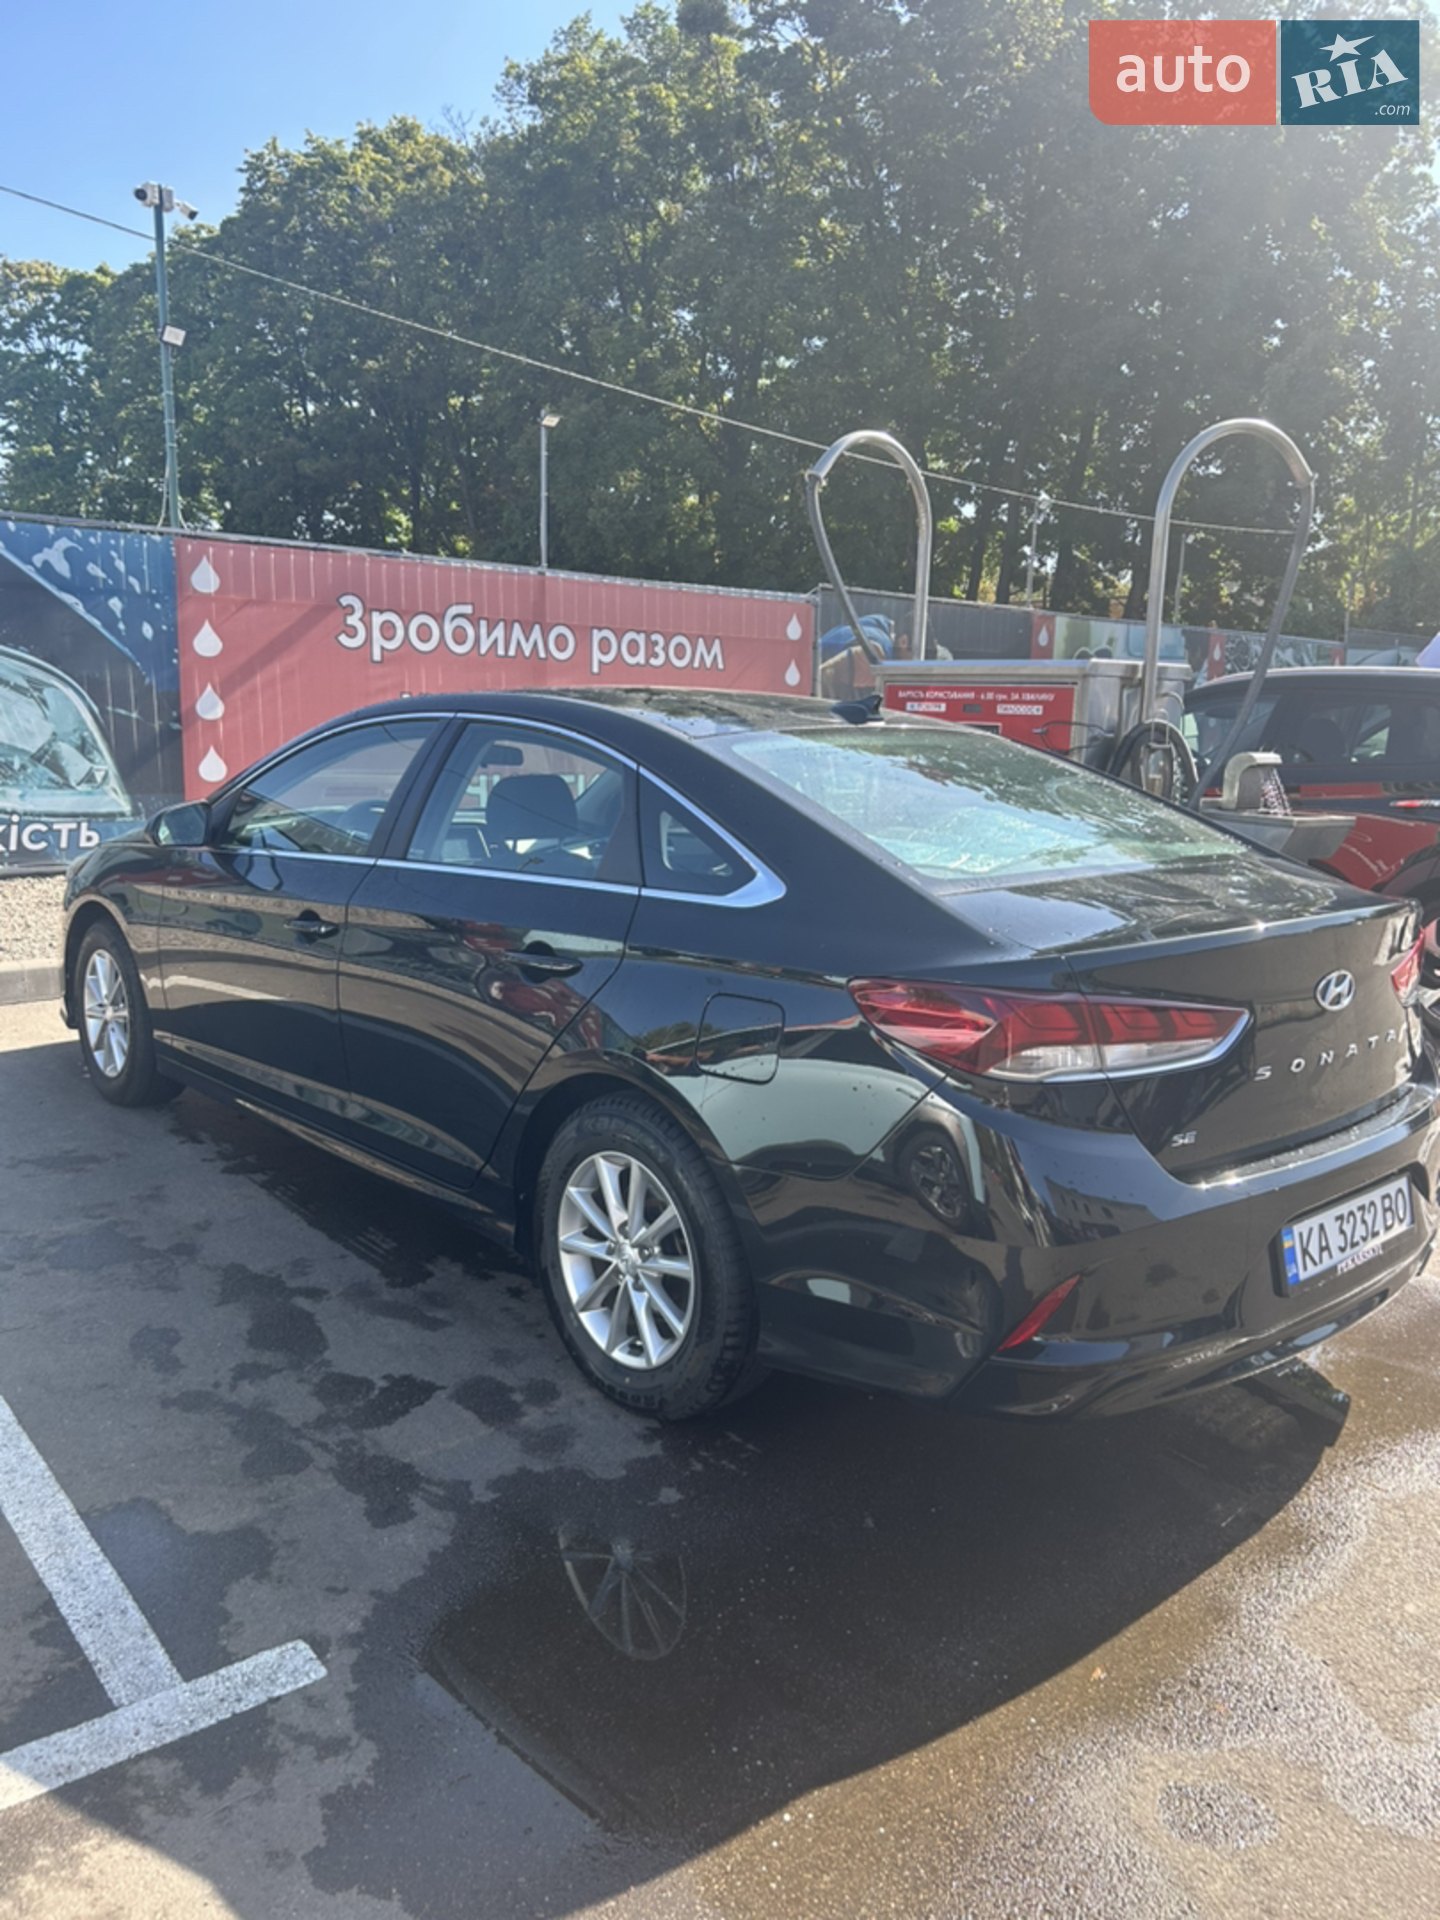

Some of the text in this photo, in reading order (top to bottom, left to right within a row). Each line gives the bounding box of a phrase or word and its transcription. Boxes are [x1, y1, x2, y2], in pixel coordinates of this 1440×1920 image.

[335, 594, 725, 675] Зробимо разом
[1254, 1029, 1397, 1081] SONATA
[1171, 1130, 1198, 1147] SE
[1299, 1223, 1334, 1272] KA
[1334, 1200, 1380, 1254] 3232
[1381, 1187, 1407, 1232] BO
